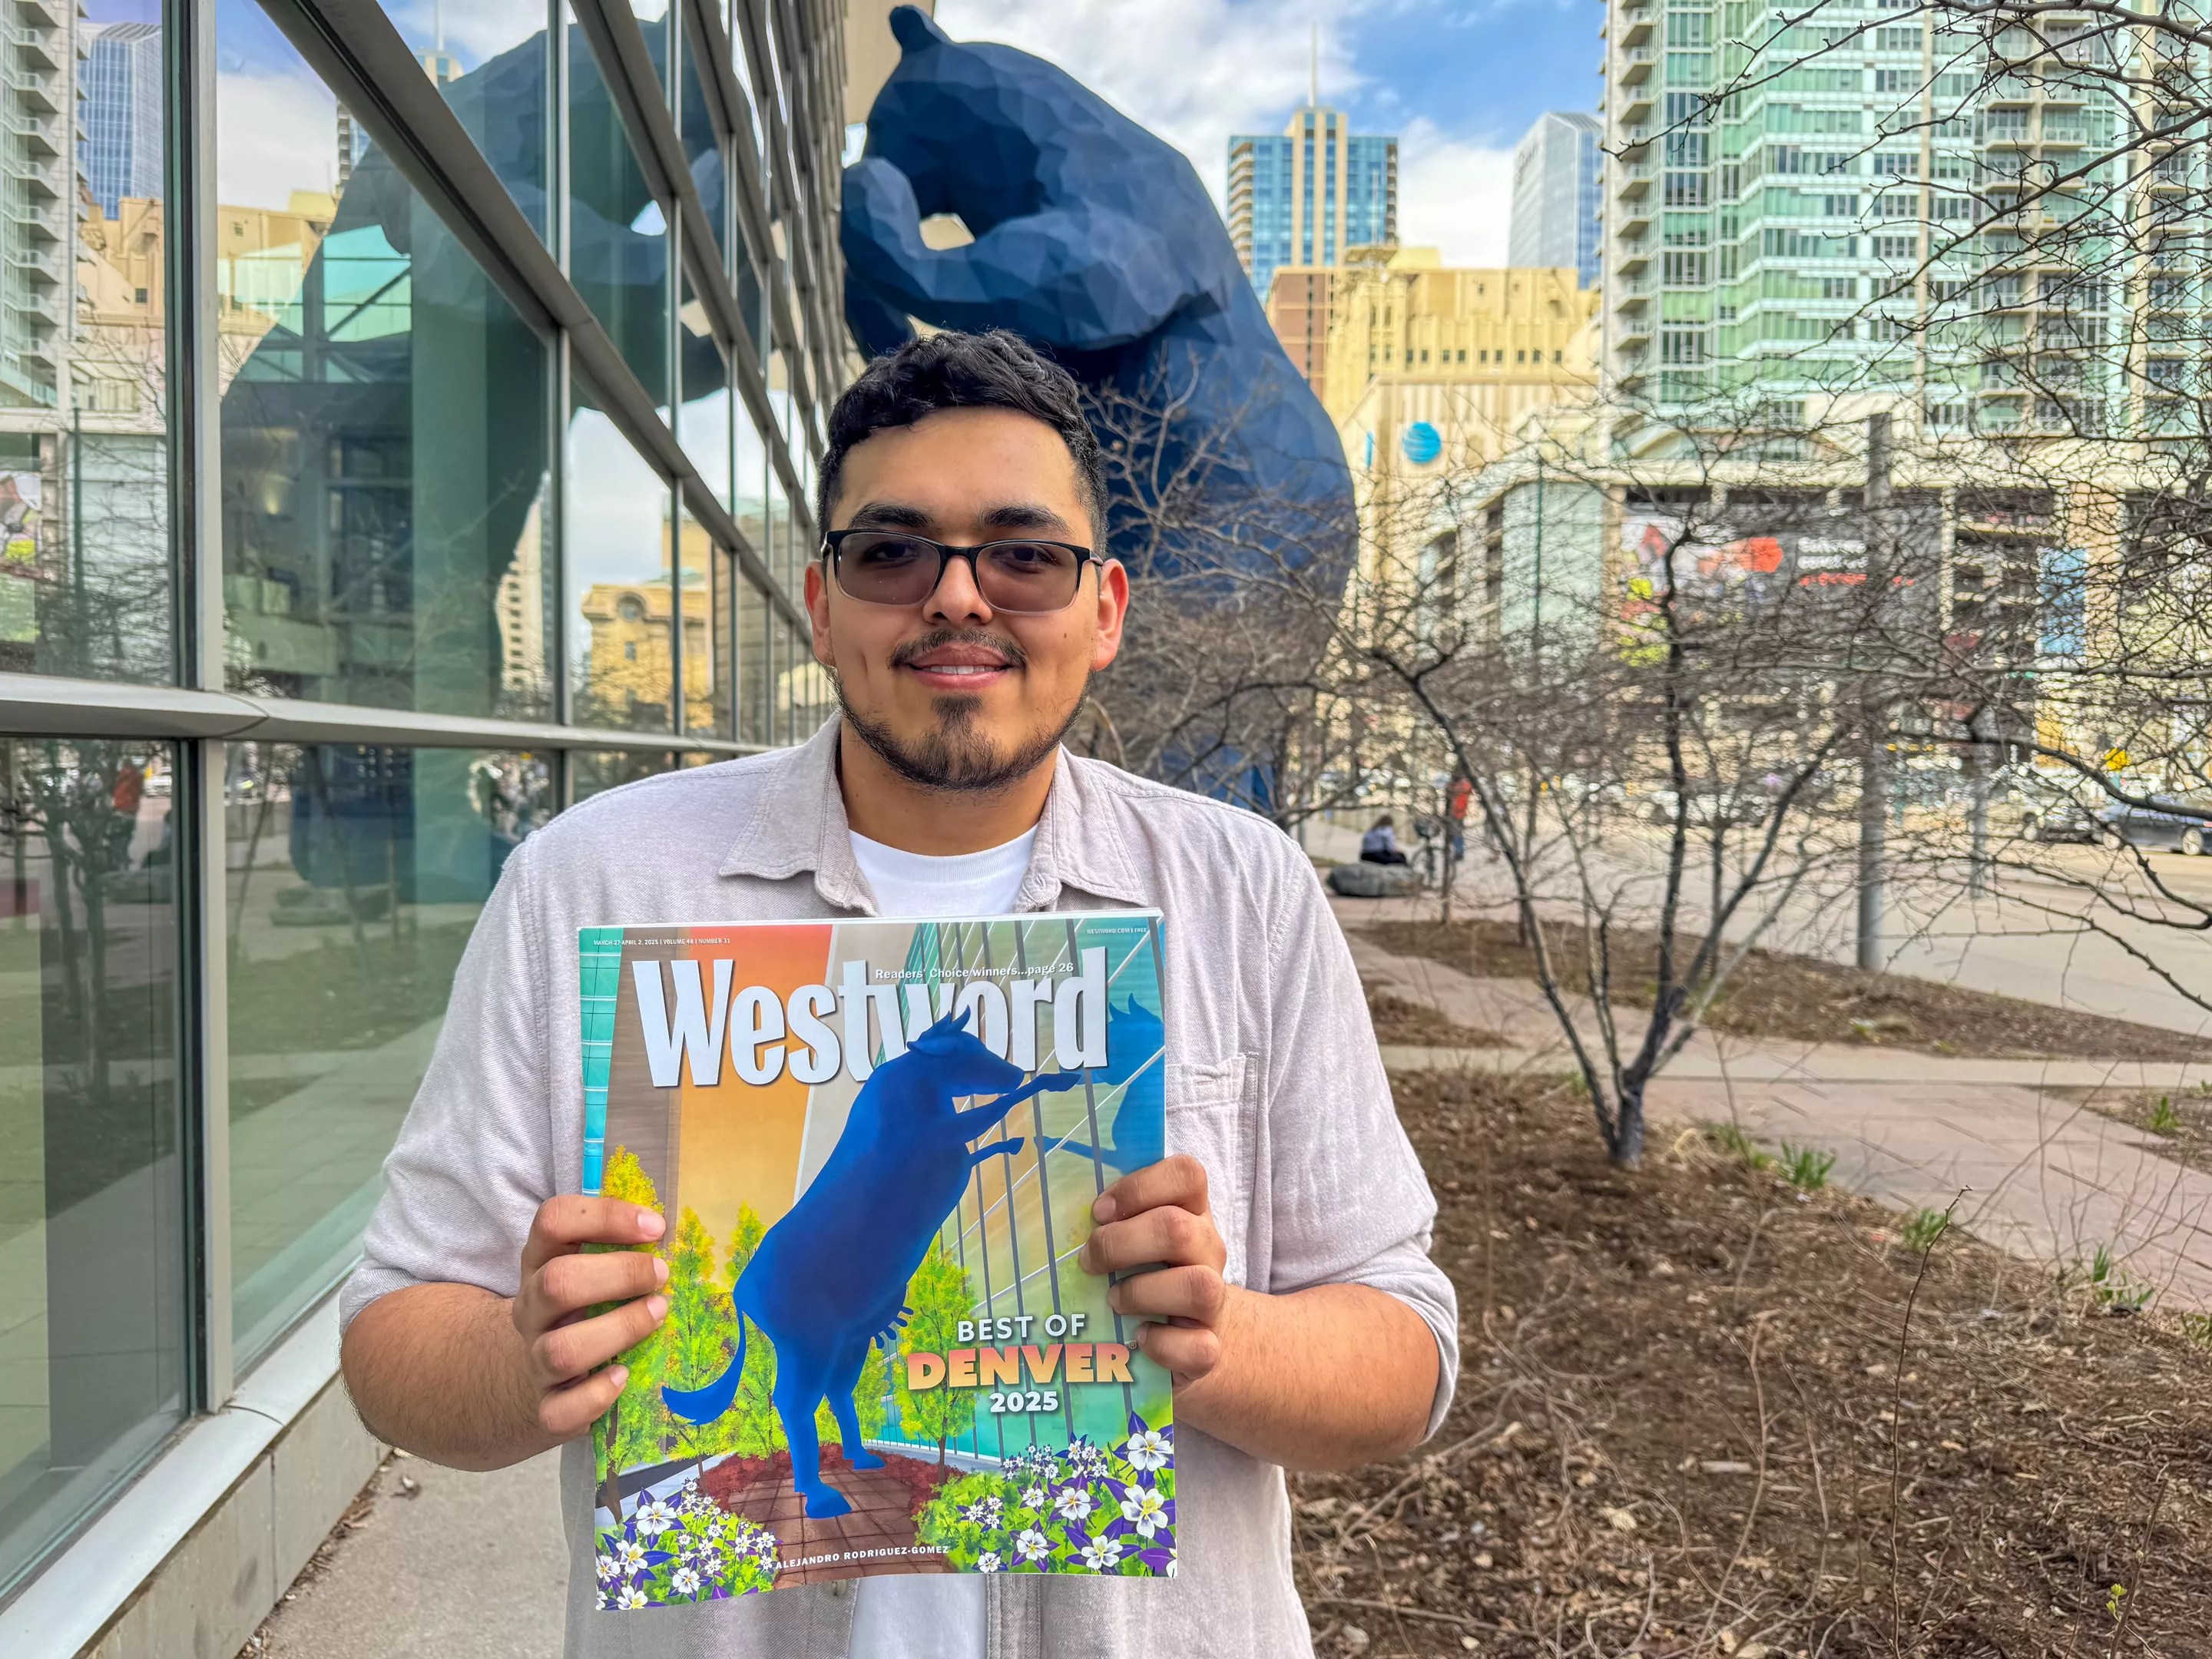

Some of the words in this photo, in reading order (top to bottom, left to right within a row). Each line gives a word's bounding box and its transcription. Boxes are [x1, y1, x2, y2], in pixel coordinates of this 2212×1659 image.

[929, 967, 969, 979] Choice
[1058, 962, 1075, 973] 26
[631, 945, 1109, 1088] Westword
[958, 1316, 1034, 1342] BEST
[1044, 1313, 1085, 1337] OF
[988, 1391, 1059, 1413] 2025
[774, 1554, 839, 1570] ALEJANDRO
[843, 1545, 949, 1561] RODRIGUEZ-GOMEZ
